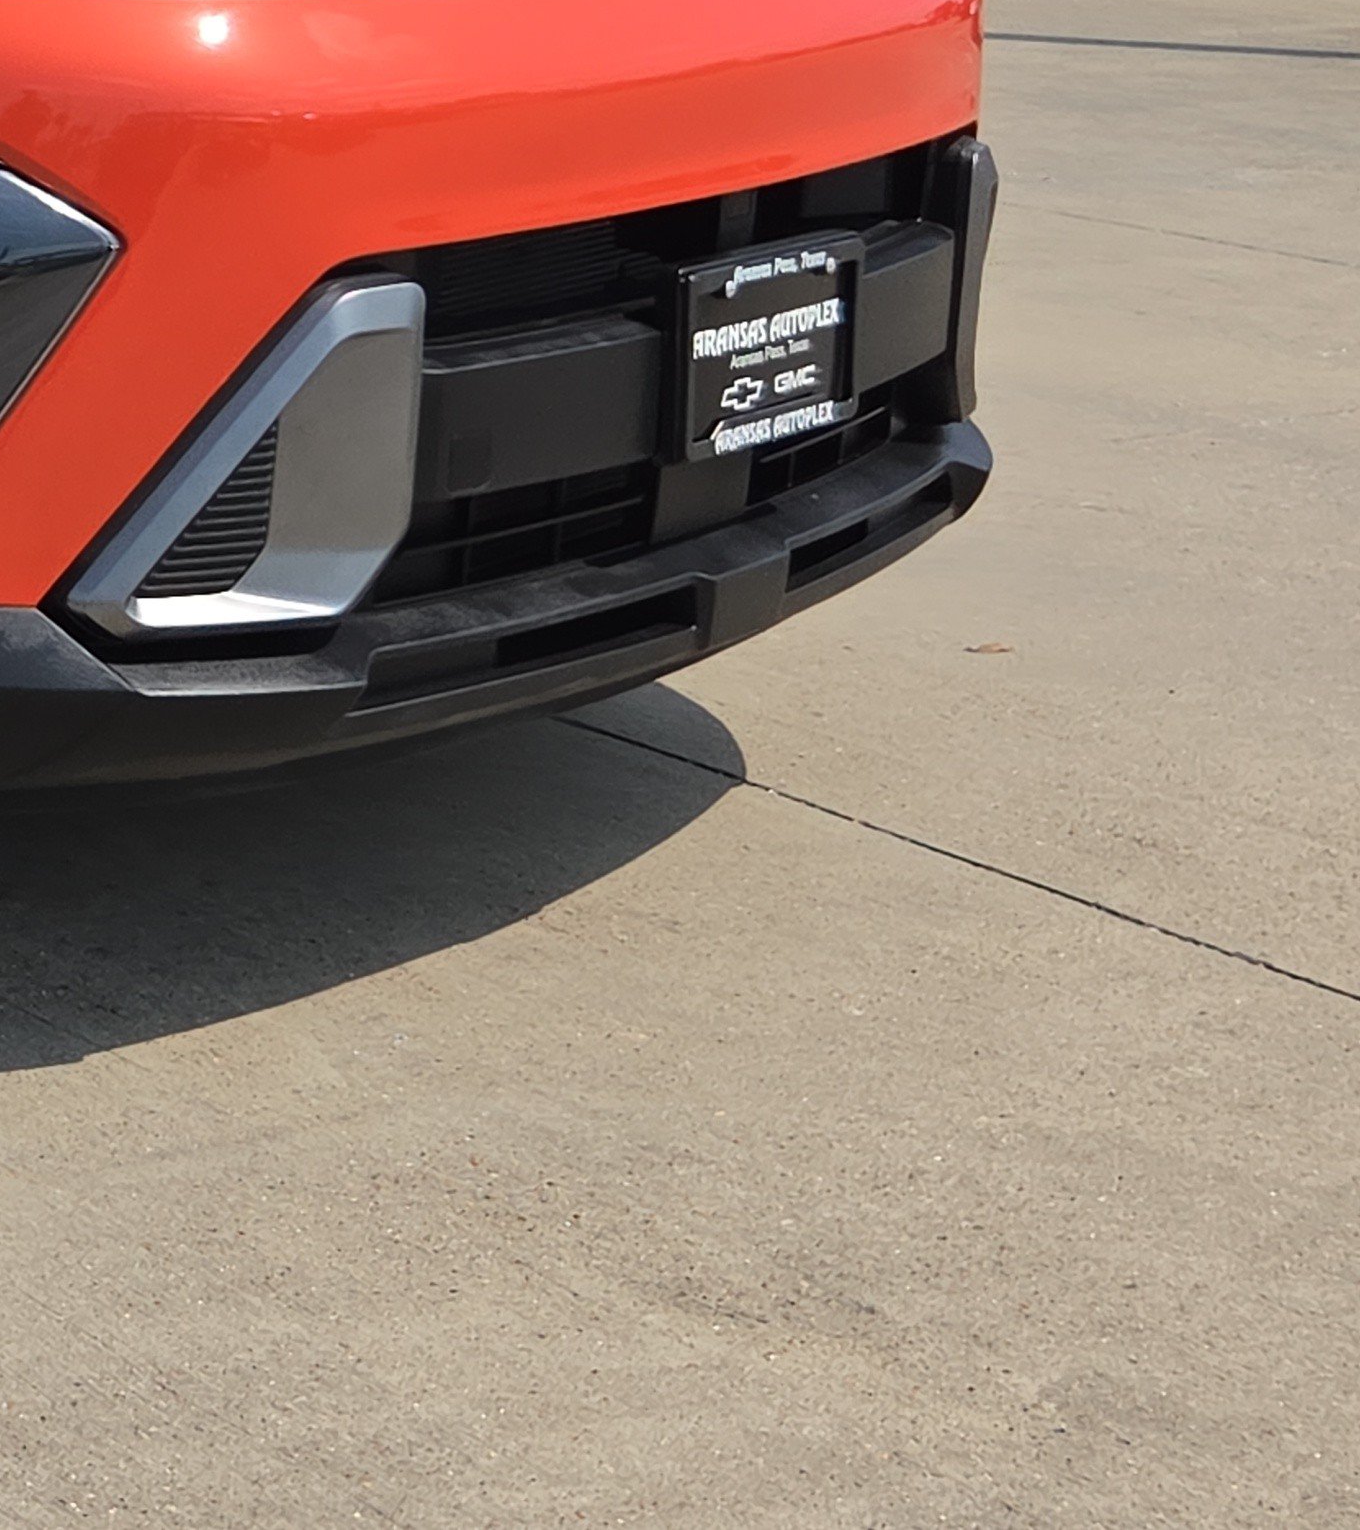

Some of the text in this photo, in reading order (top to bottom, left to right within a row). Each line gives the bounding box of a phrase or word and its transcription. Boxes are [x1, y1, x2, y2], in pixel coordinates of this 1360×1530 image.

[692, 297, 840, 360] ARANSAS AUTOPLEX
[774, 364, 817, 393] GMC
[714, 400, 835, 456] ARANSAS AUTOPLEX
